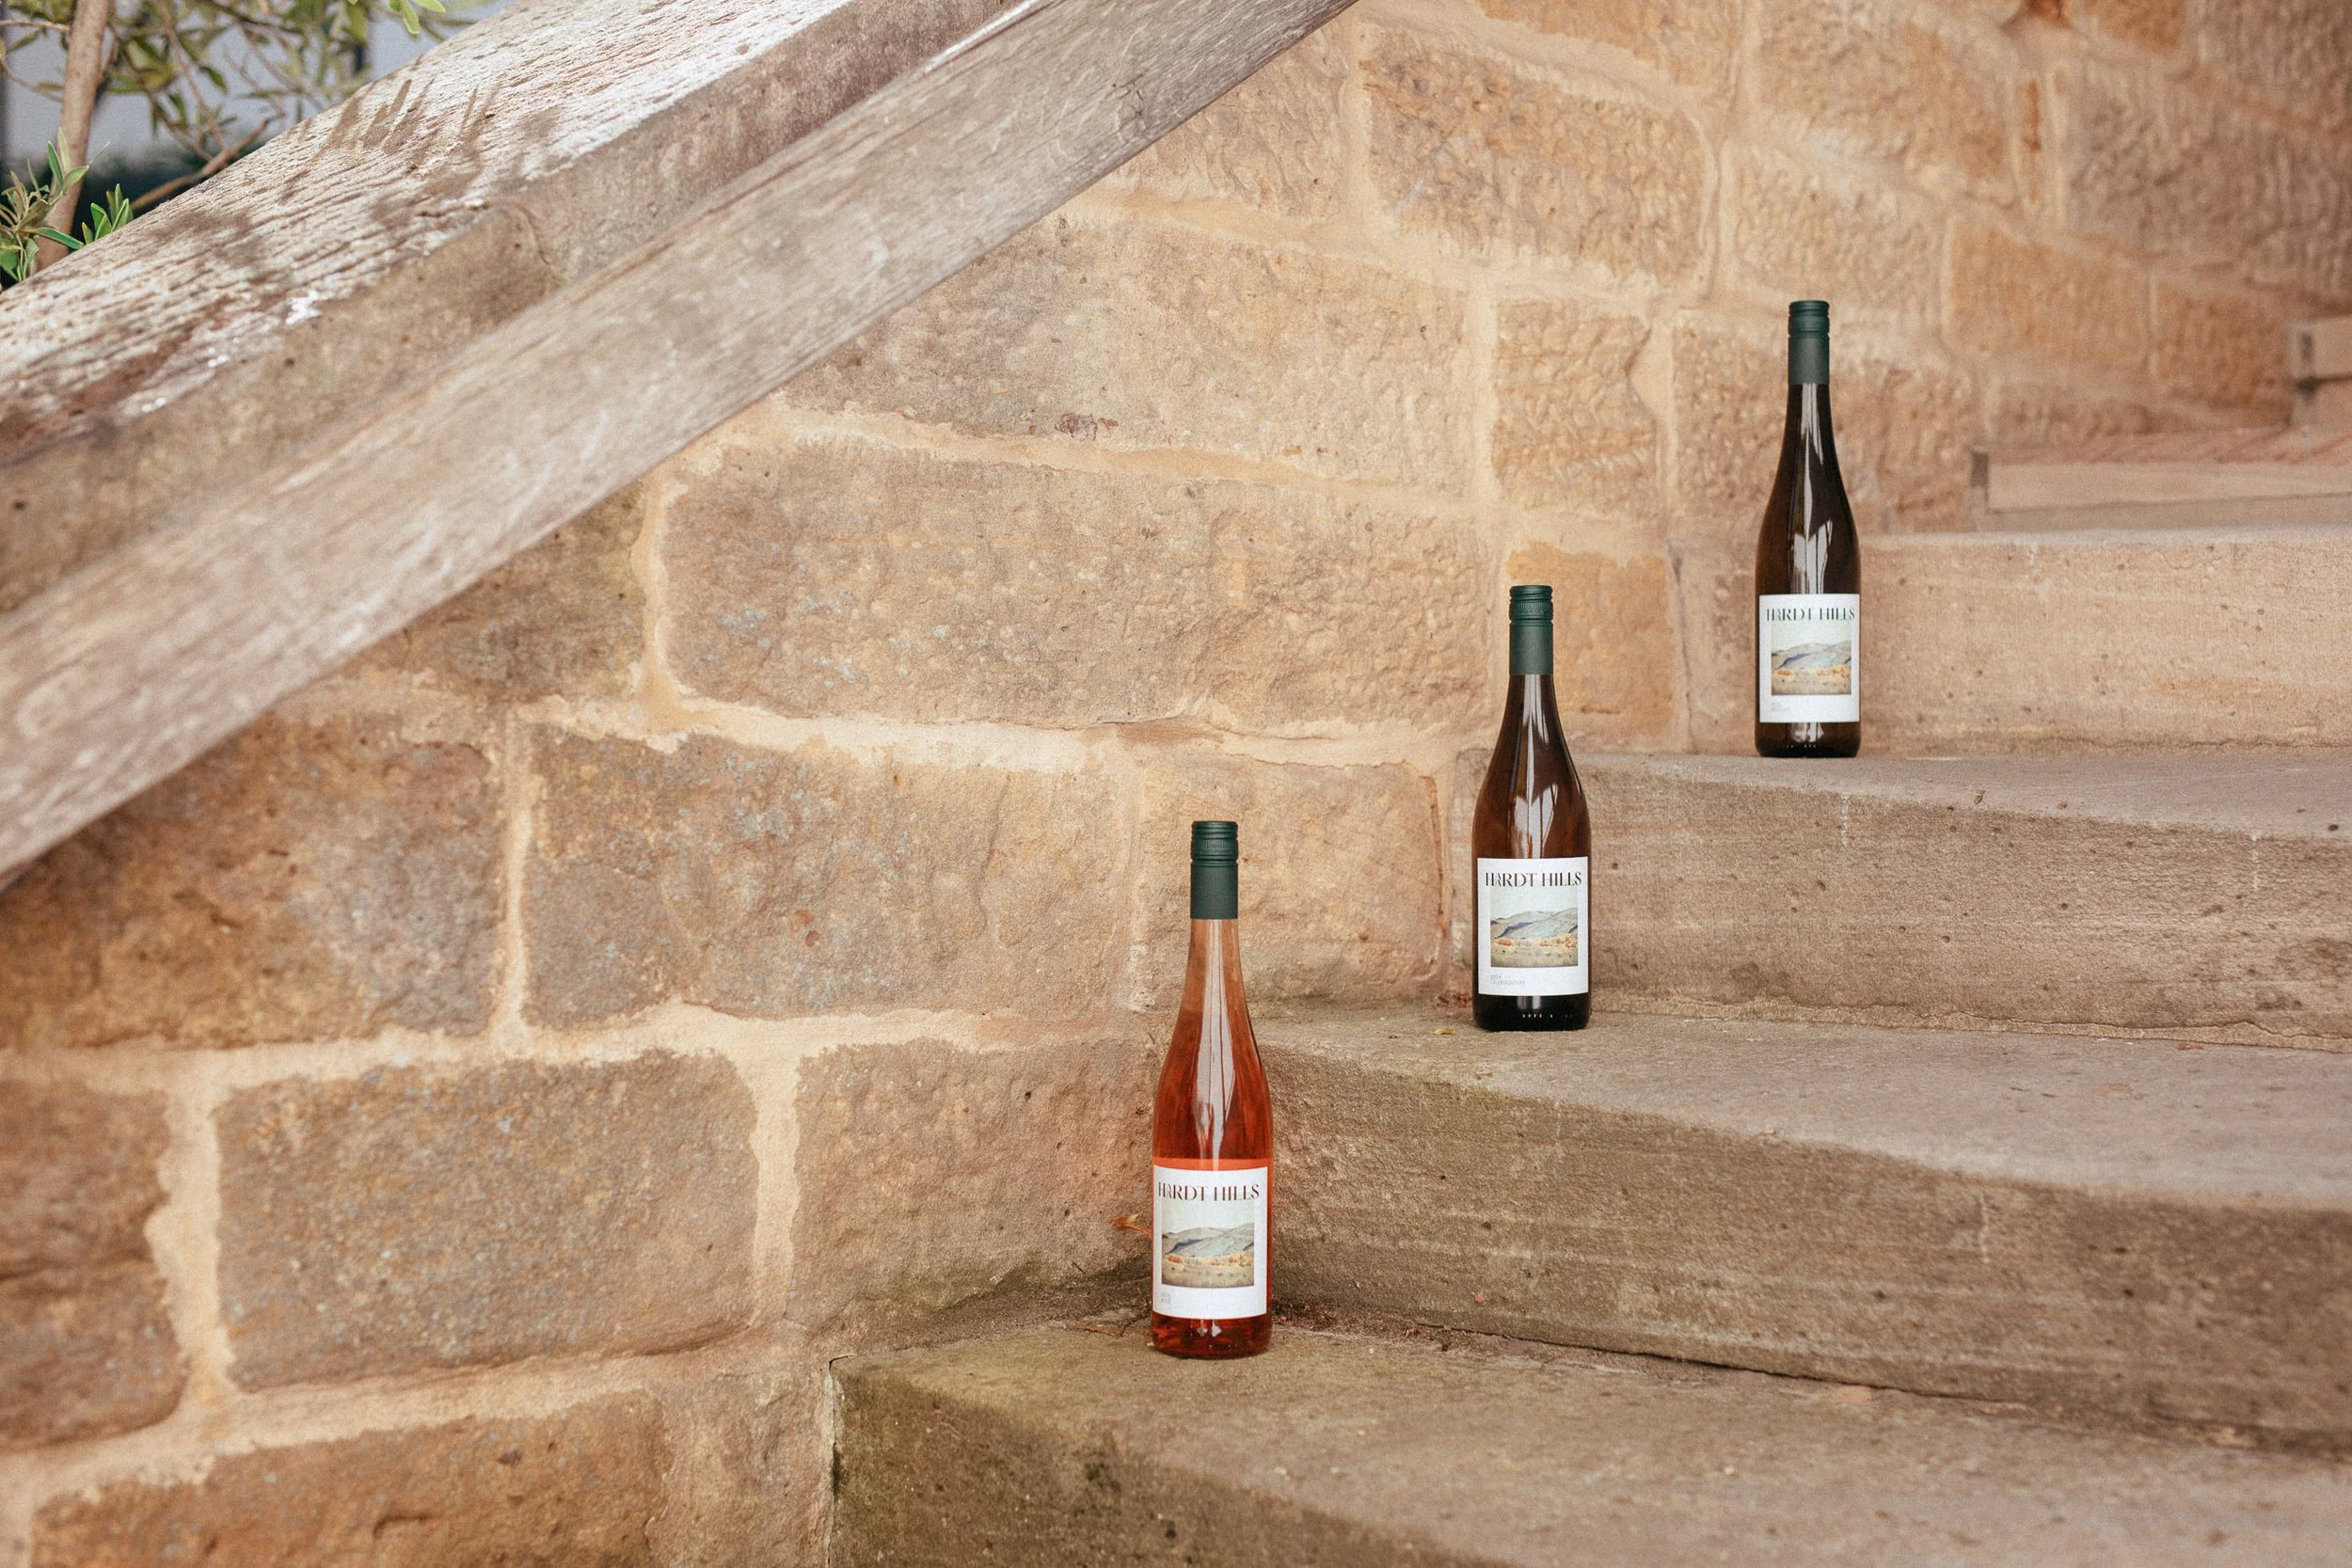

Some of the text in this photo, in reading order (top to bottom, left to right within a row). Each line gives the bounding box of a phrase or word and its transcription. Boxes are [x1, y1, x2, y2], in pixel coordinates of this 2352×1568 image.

[1820, 607, 1856, 621] HILLS
[1486, 871, 1582, 887] HARDT HILLS
[1158, 1181, 1261, 1201] HARDT HILLS
